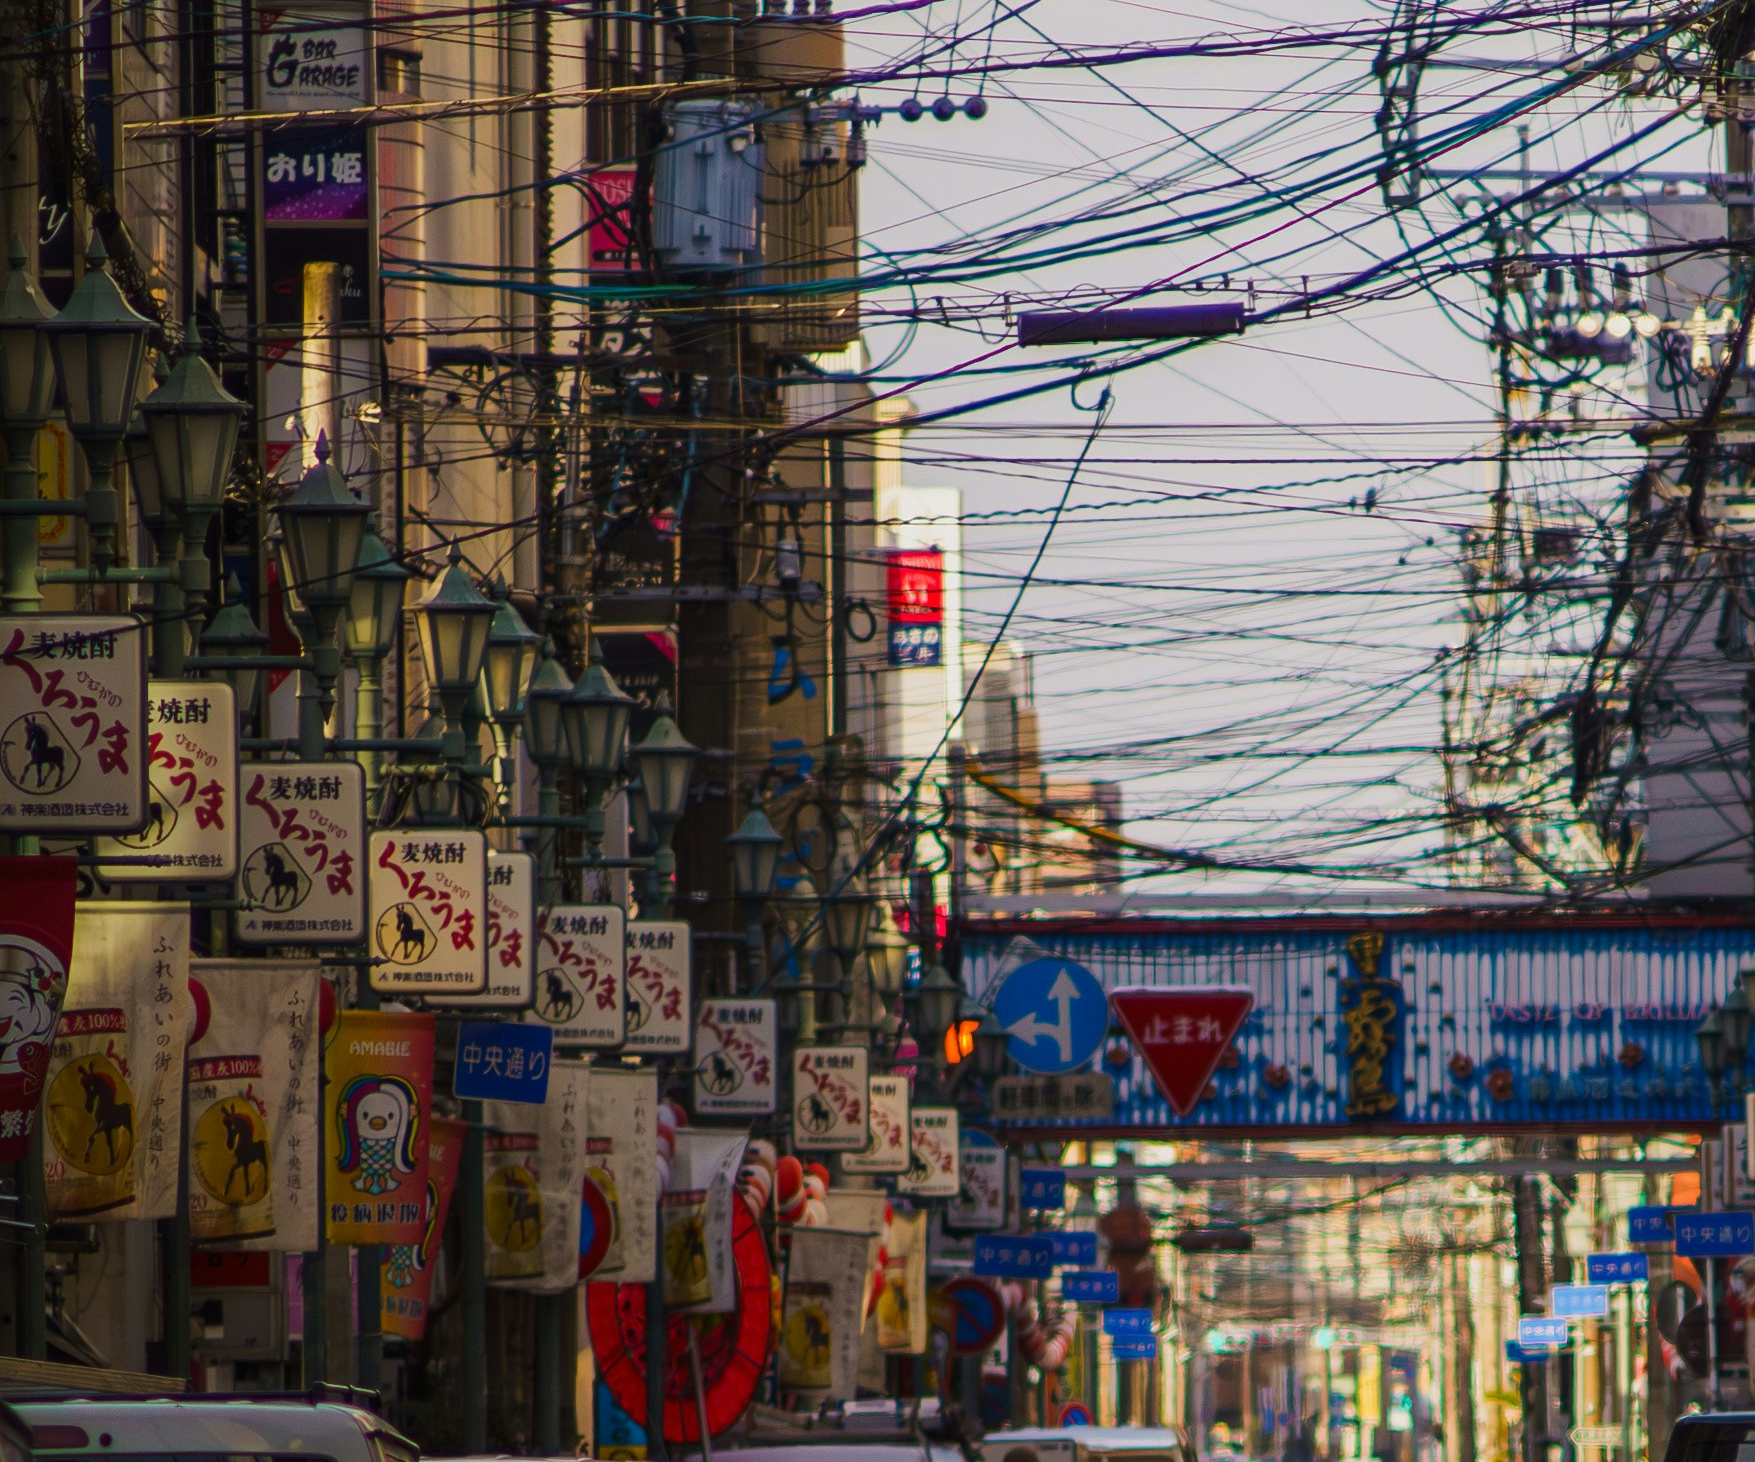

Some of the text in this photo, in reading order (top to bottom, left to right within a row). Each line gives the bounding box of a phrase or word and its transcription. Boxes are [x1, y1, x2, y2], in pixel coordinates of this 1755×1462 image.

[303, 40, 337, 58] BAR
[267, 152, 362, 183] おり姫
[32, 631, 117, 659] 麦焼酎
[270, 776, 342, 800] 麦焼酎
[401, 842, 467, 864] 麦焼酎
[552, 916, 609, 936] 麦焼酎
[1146, 1014, 1223, 1045] 止まれ
[350, 1040, 413, 1058] AMABIE
[462, 1041, 547, 1081] 中央通り
[1681, 1223, 1751, 1245] 中央通り
